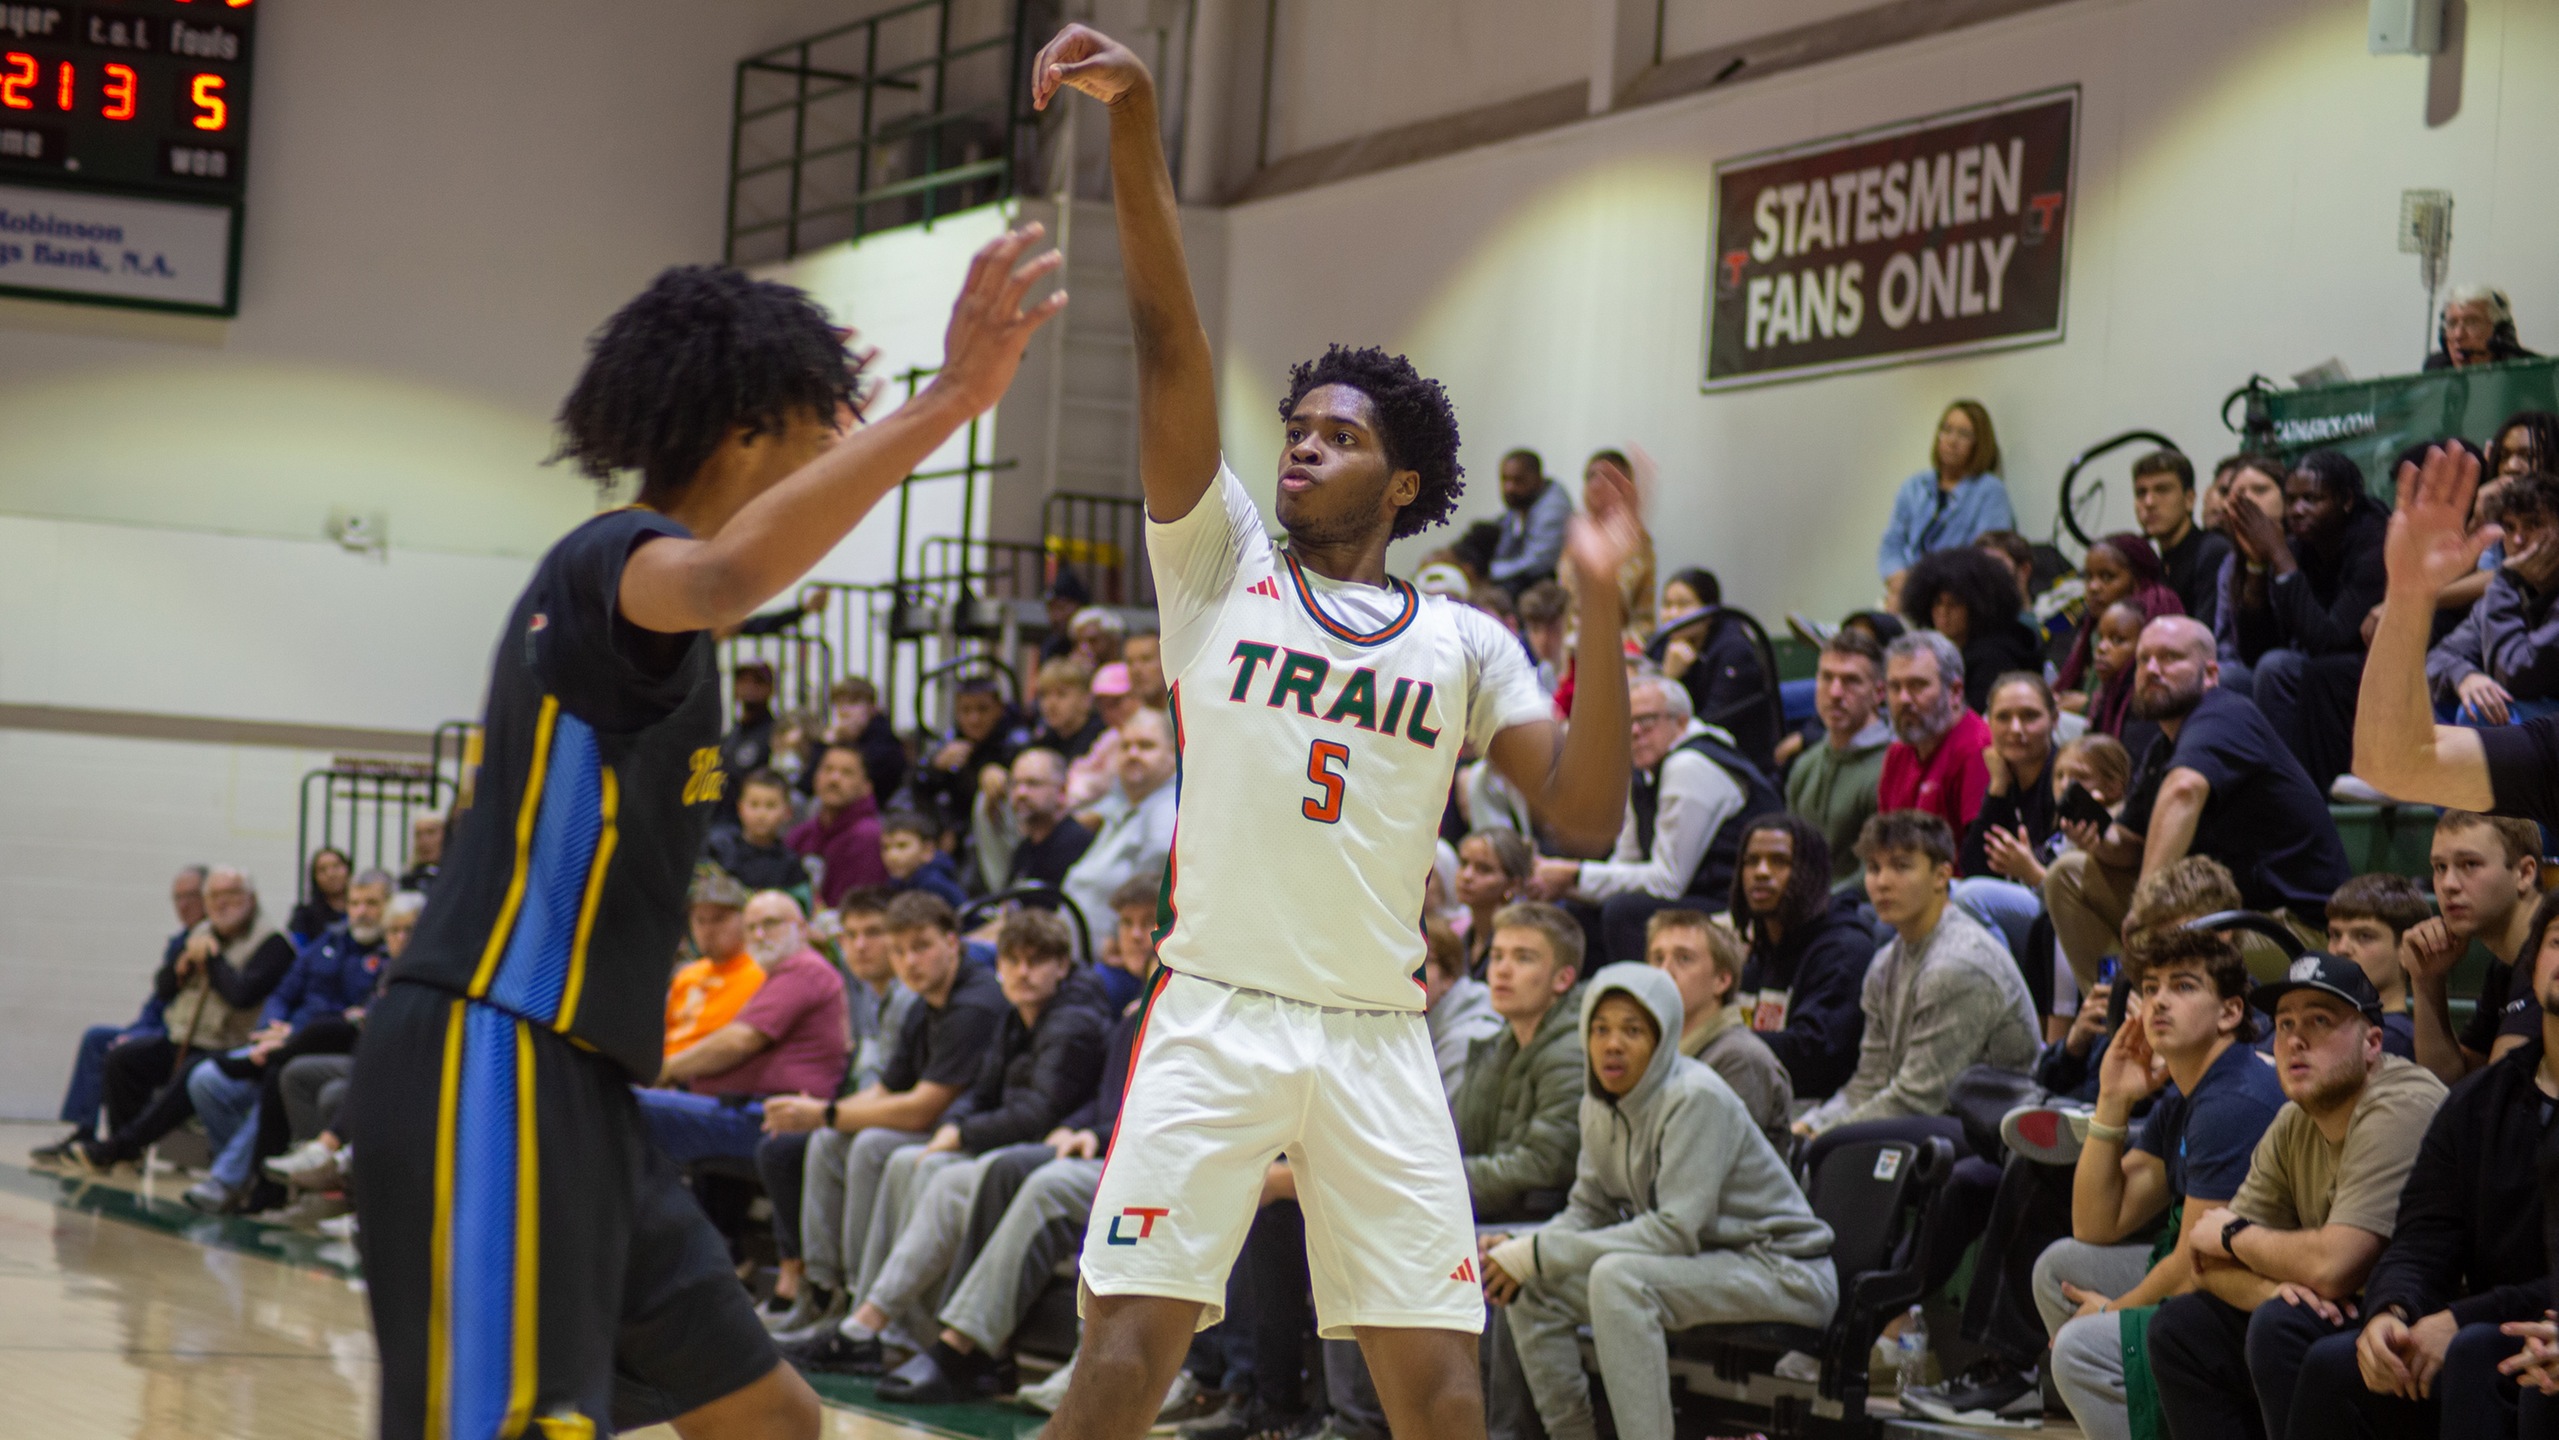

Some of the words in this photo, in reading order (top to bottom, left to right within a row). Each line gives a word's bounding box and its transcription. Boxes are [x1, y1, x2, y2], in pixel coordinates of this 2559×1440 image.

[0, 51, 75, 112] 21
[102, 62, 138, 121] 3
[191, 73, 228, 131] 5
[1751, 138, 2024, 263] STATESMEN
[1744, 260, 1864, 350] FANS
[1877, 234, 2017, 330] ONLY
[1228, 640, 1442, 749] TRAIL
[1301, 738, 1350, 824] 5
